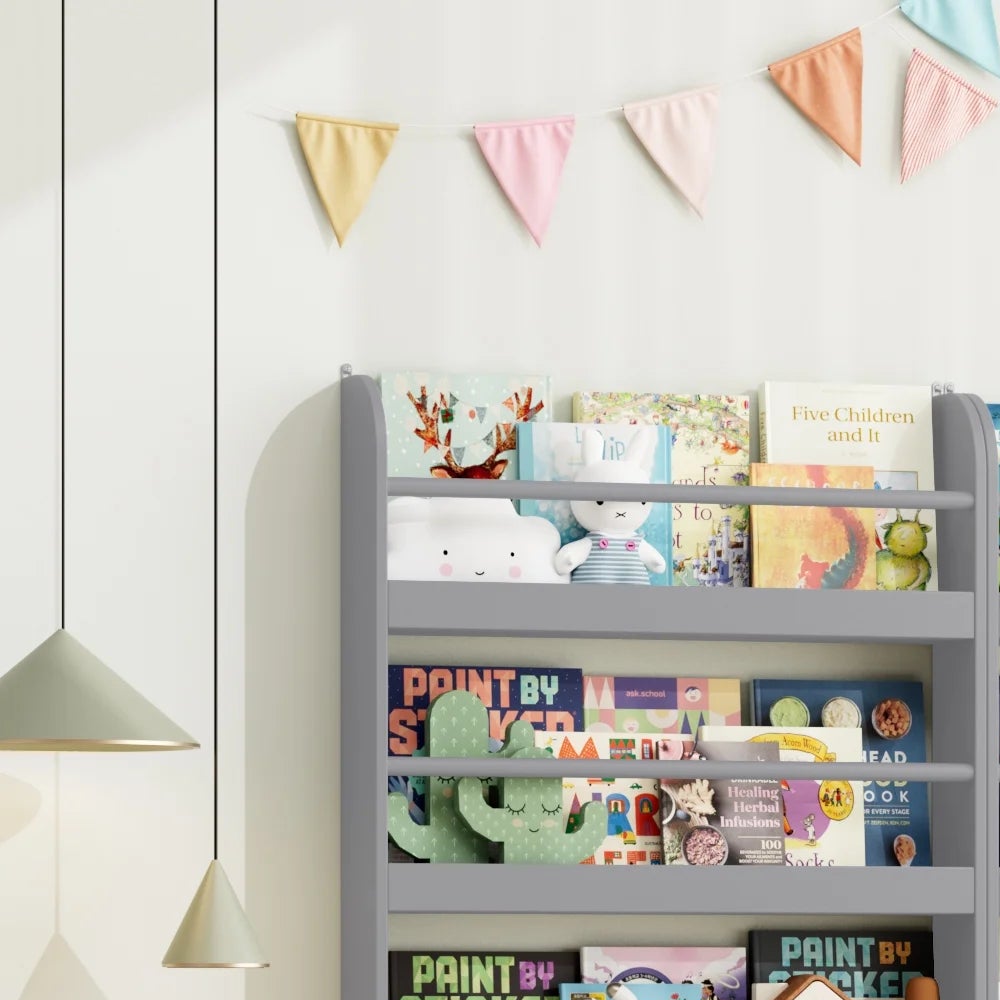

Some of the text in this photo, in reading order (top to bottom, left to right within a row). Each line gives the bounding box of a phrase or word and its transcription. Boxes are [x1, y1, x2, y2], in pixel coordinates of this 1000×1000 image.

[792, 406, 916, 425] Five Children
[827, 429, 882, 443] and It
[403, 668, 559, 708] PAINT BY
[727, 786, 780, 800] Healing
[733, 802, 780, 813] Herbal
[720, 815, 781, 828] Infusions
[760, 839, 782, 850] 100
[781, 936, 912, 968] PAINT BY
[412, 955, 555, 994] PAINT BY
